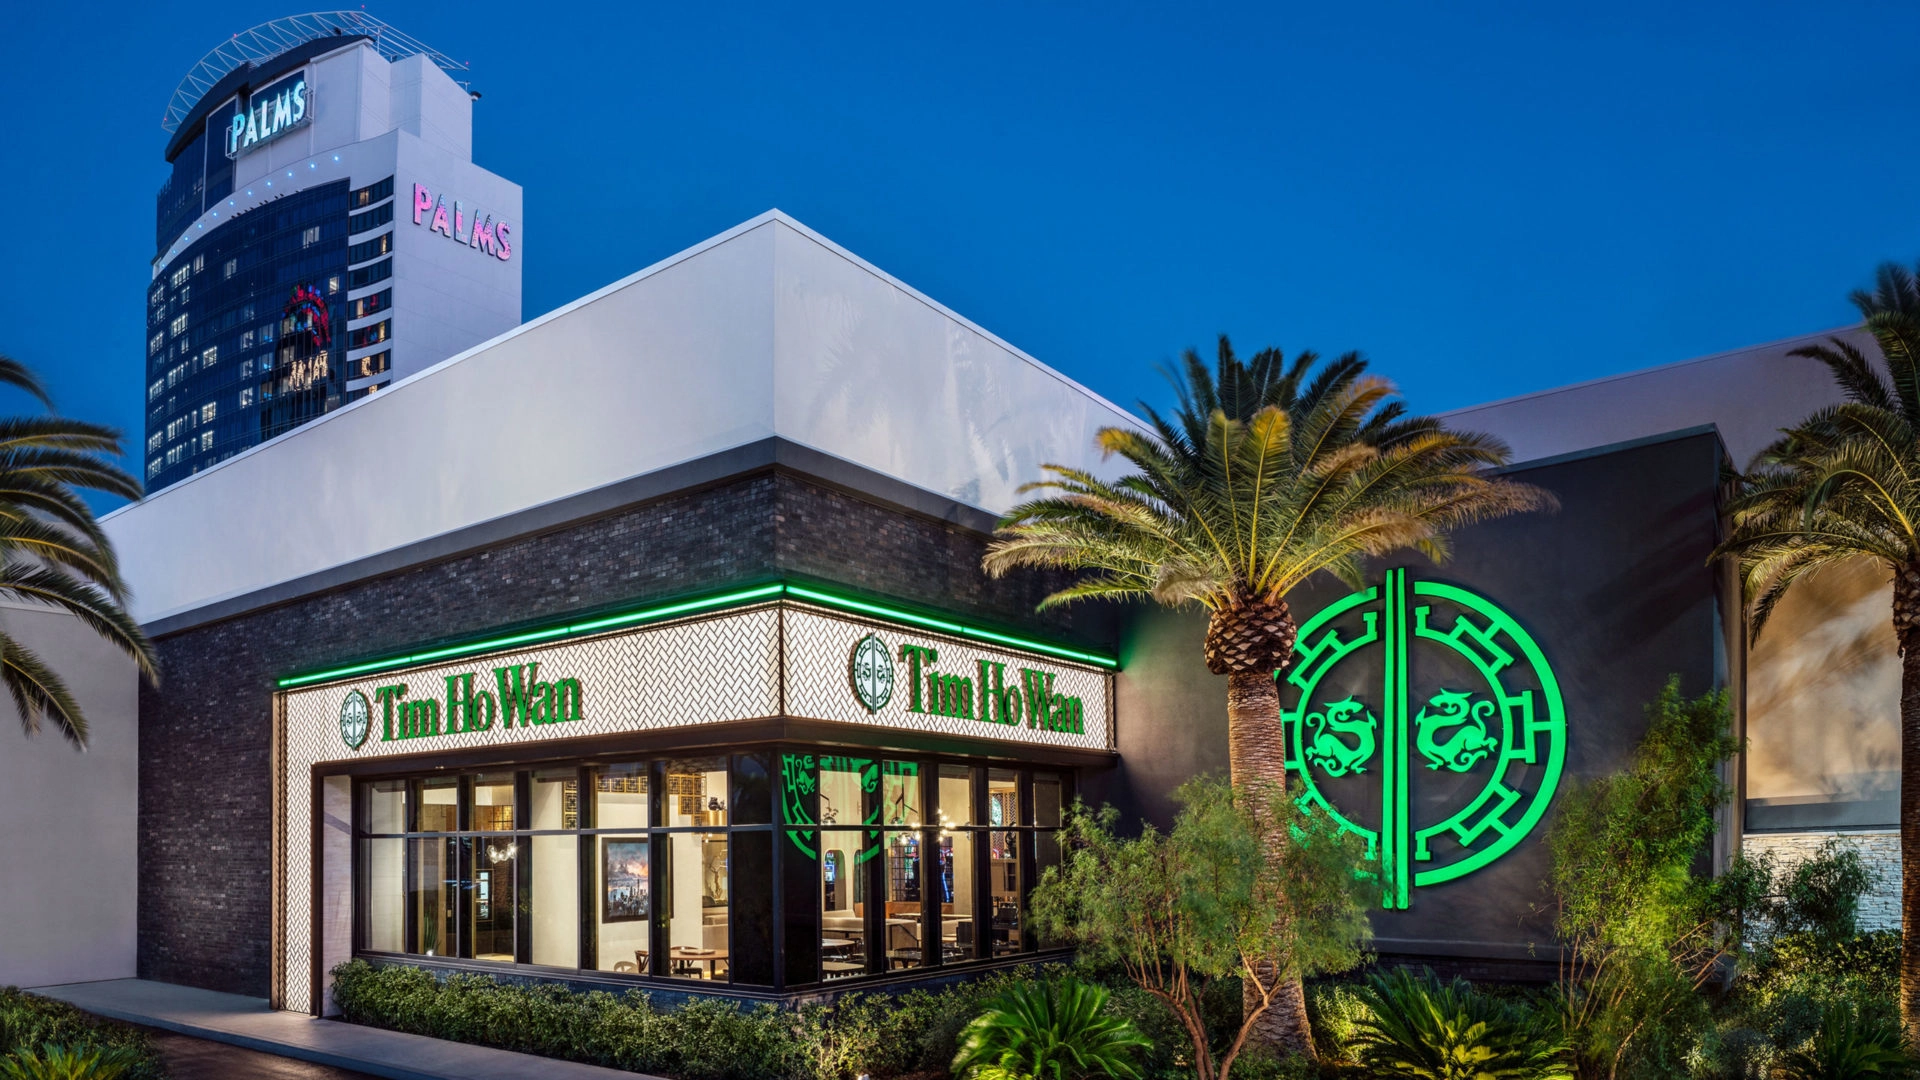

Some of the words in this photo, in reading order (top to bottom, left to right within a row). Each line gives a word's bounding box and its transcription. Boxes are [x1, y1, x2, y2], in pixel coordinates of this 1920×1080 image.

[231, 81, 306, 153] PALMS
[413, 182, 511, 262] PALMS
[375, 683, 440, 742] Tim
[444, 672, 493, 735] Ho
[493, 661, 584, 729] Wan
[902, 643, 975, 720] Tim
[978, 659, 1023, 727] Ho
[1022, 667, 1085, 735] Wan
